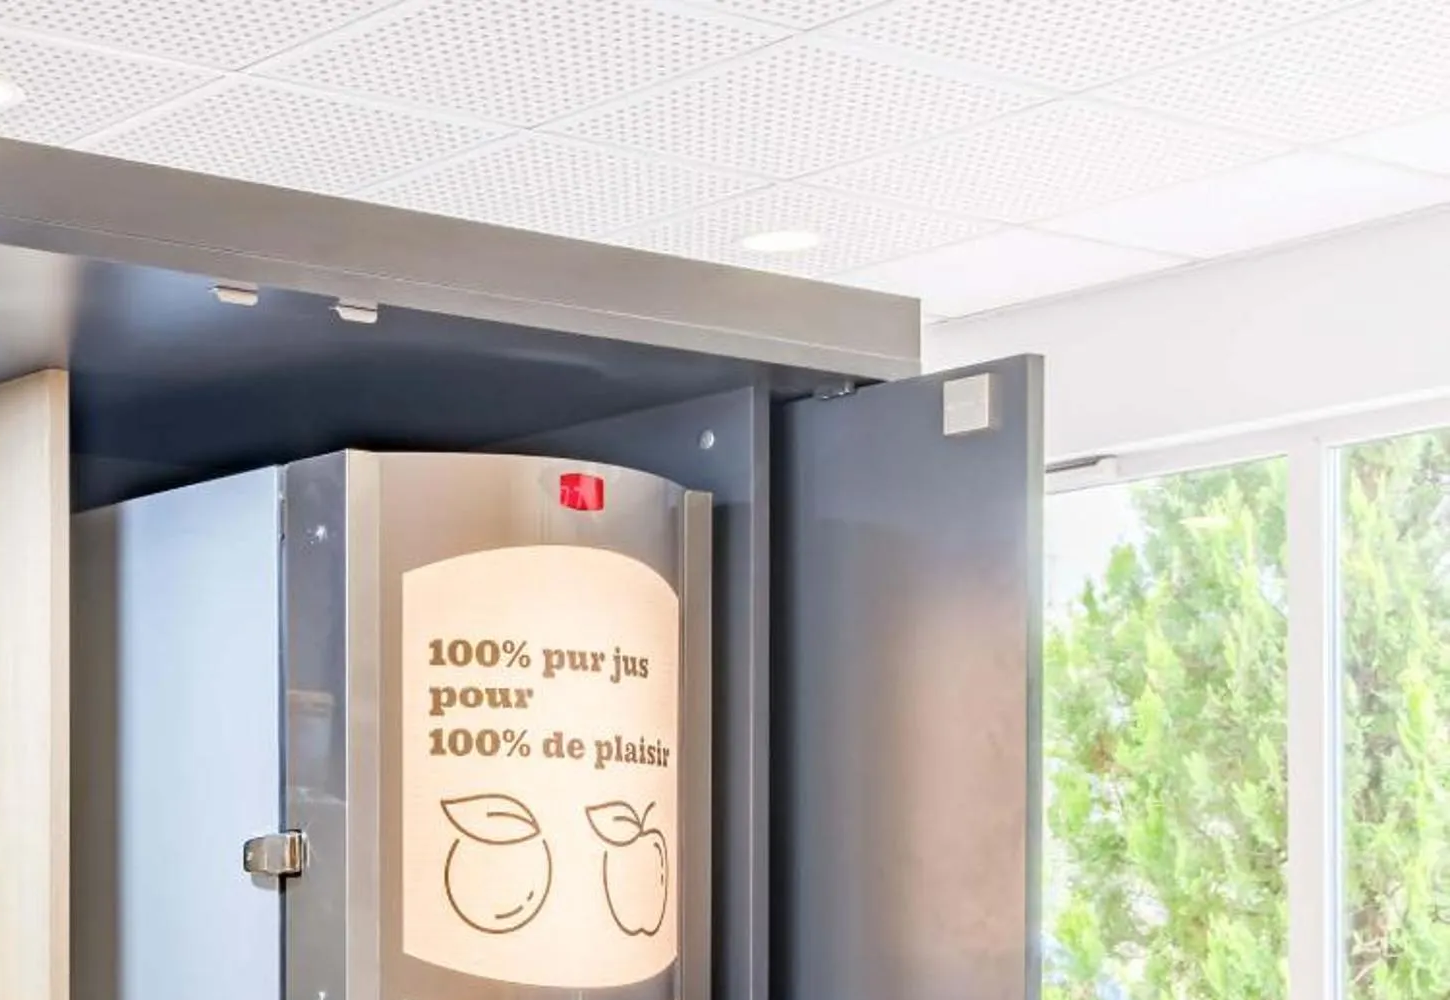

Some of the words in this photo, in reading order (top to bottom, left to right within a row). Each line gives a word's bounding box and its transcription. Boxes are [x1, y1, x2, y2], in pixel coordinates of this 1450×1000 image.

[429, 639, 531, 669] 100%
[542, 647, 606, 679] pur
[610, 646, 650, 683] jus
[429, 686, 534, 717] pour
[429, 728, 531, 758] 100%
[542, 732, 586, 759] de
[594, 735, 671, 770] plaisir
